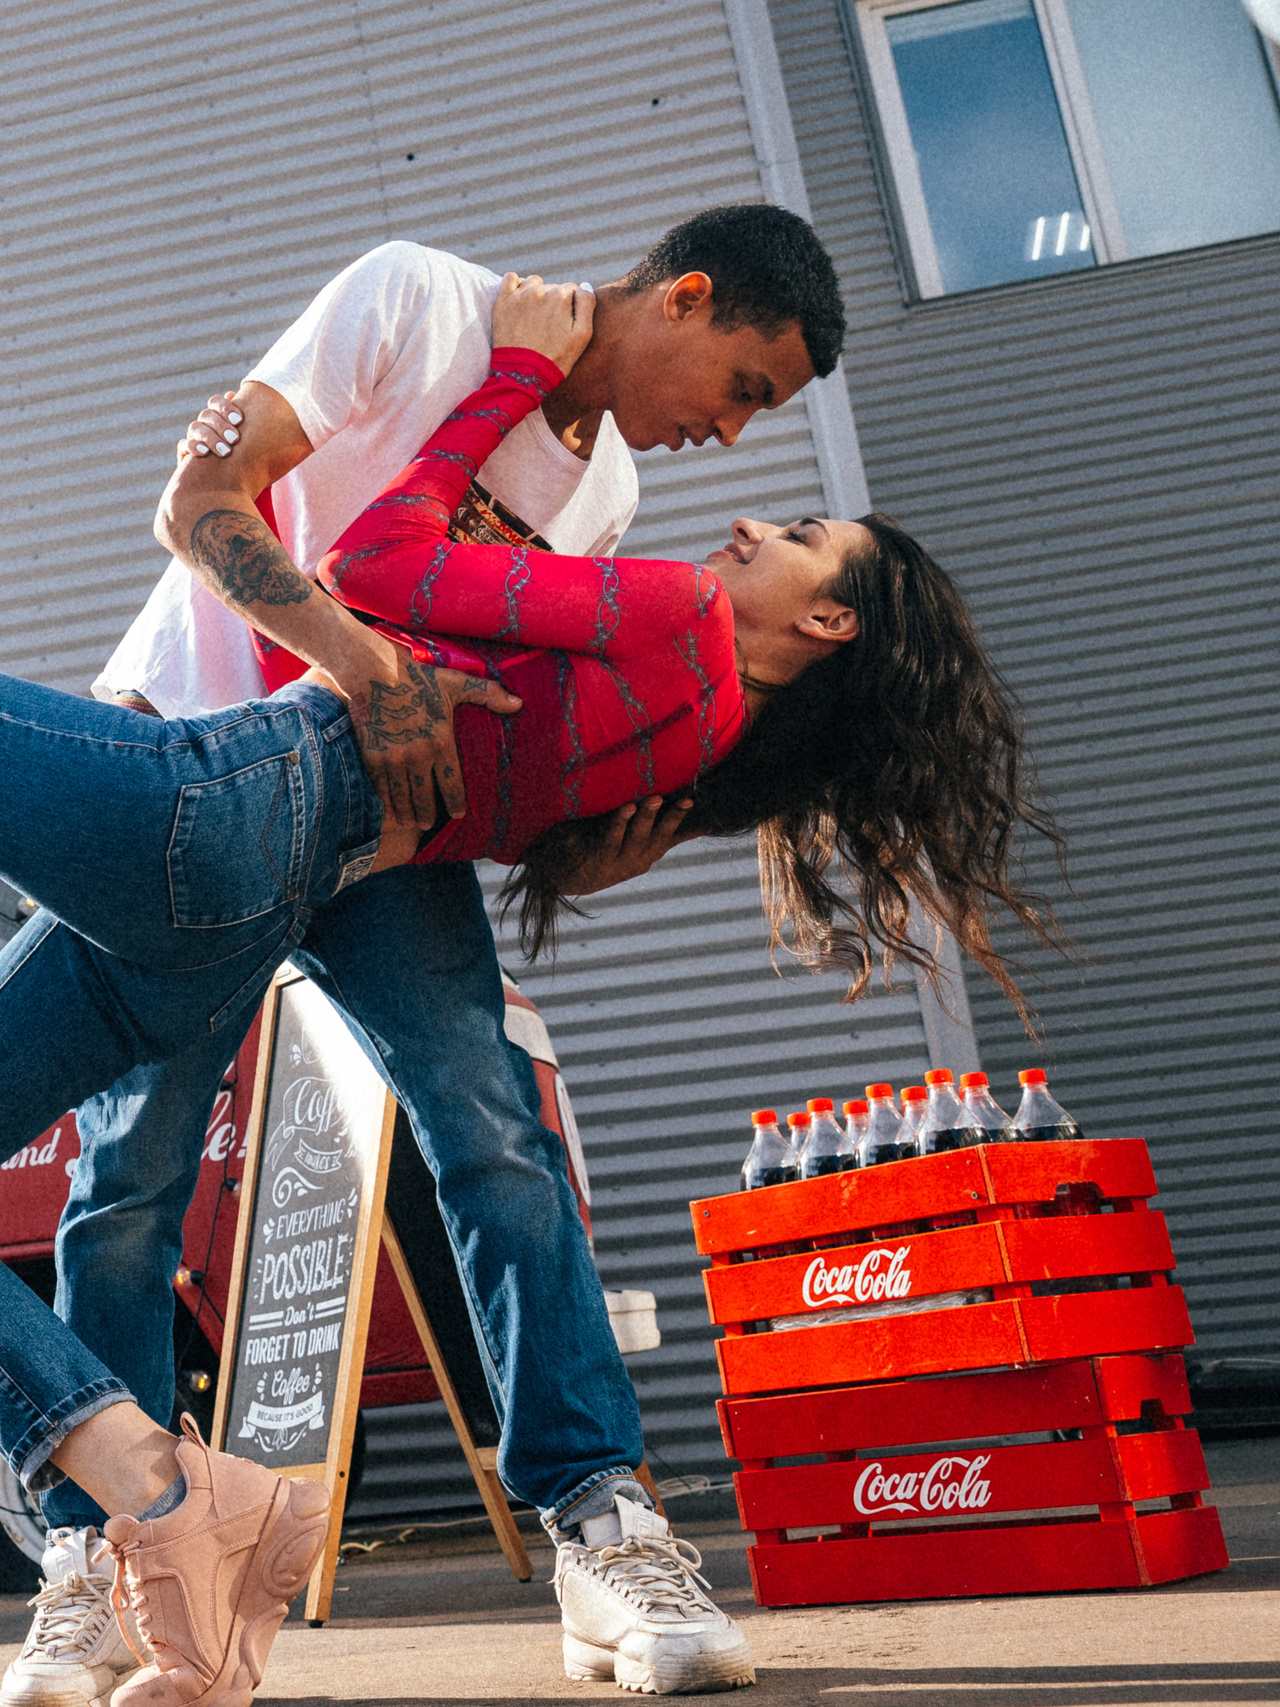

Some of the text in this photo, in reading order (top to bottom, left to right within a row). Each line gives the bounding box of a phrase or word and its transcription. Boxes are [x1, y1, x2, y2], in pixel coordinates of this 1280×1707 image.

[276, 1197, 346, 1240] EVERYTHING
[259, 1232, 349, 1306] POSSIBLE
[801, 1244, 913, 1308] Coca-Cola
[283, 1301, 316, 1327] Don't
[244, 1321, 342, 1366] FORGET TO DRINK
[271, 1366, 311, 1406] Coffee
[256, 1403, 314, 1423] BECAUSE IT'S GOOD
[853, 1453, 993, 1515] Coca-Cola
